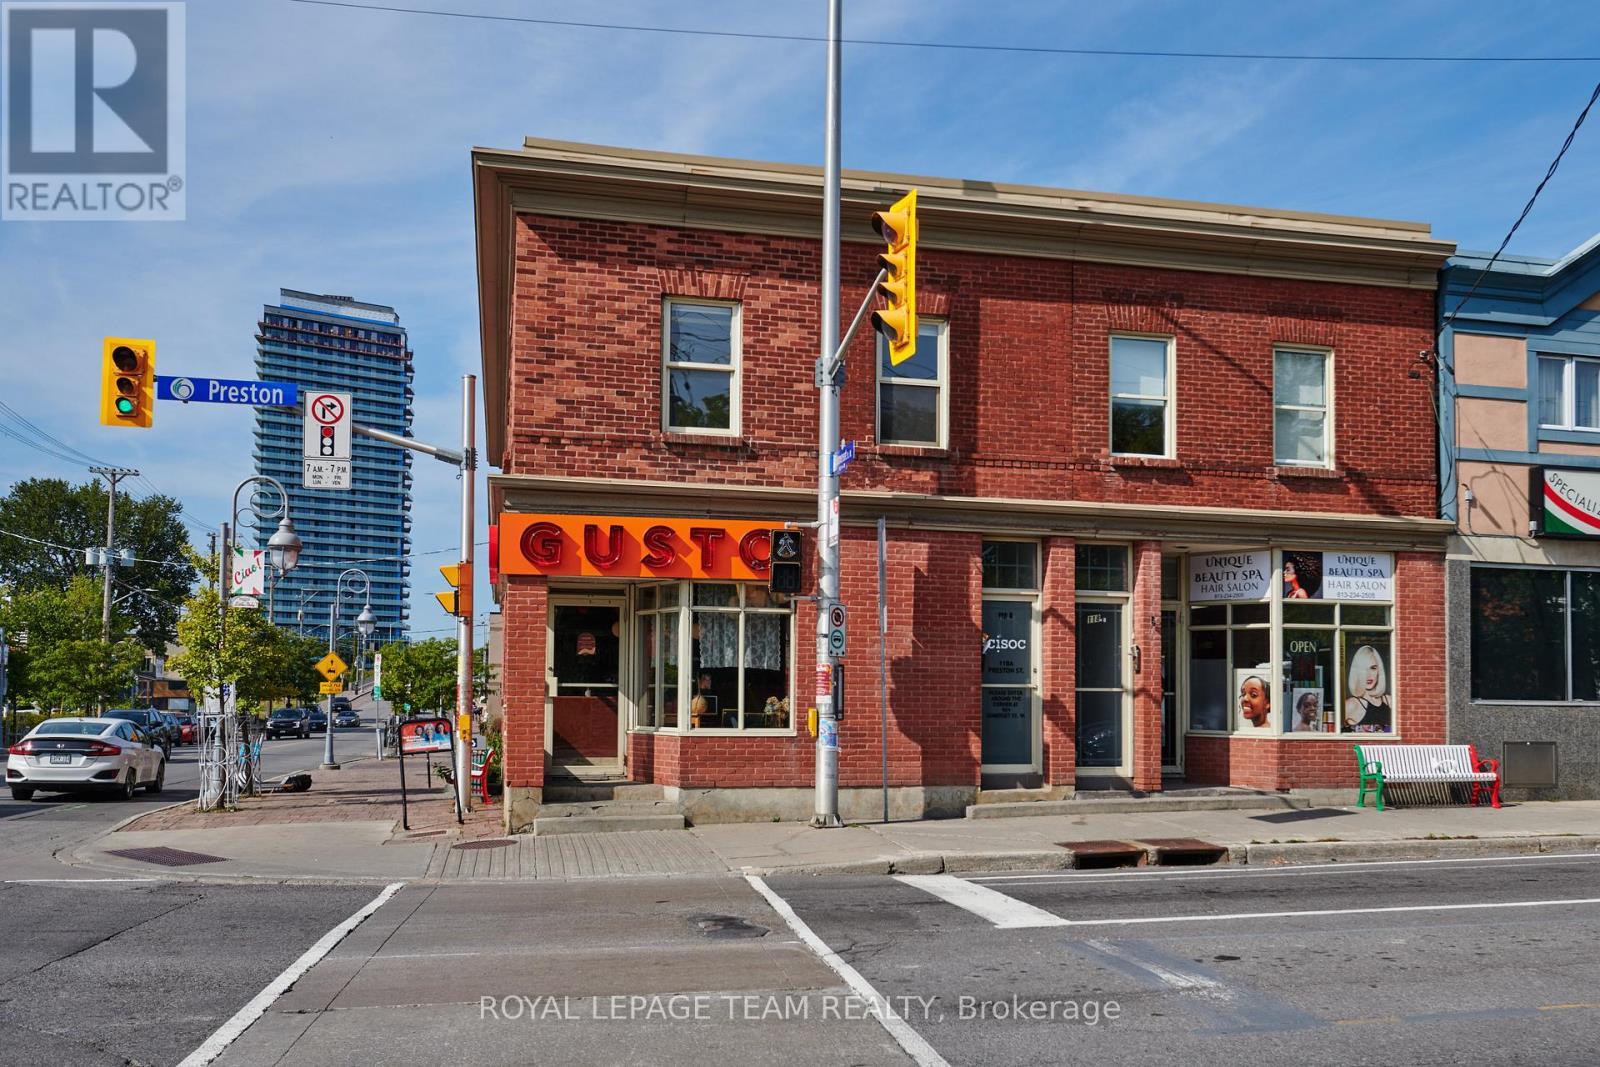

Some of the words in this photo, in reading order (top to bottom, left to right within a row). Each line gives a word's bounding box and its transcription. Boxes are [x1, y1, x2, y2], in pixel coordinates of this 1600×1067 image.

[208, 380, 283, 404] Preston
[306, 463, 311, 472] 7
[330, 464, 335, 472] 7
[1206, 554, 1253, 568] UNIQUE
[1337, 554, 1376, 567] UNIQUE
[234, 557, 262, 585] Ciao!
[1195, 571, 1238, 583] BEAUTY
[1241, 569, 1264, 581] SPA
[1328, 567, 1364, 577] BEAUTY
[1367, 568, 1385, 578] SPA
[1201, 583, 1224, 593] HAIR
[1227, 582, 1258, 592] SALON
[1327, 580, 1351, 589] HAIR
[1355, 581, 1387, 590] SALON
[1290, 640, 1317, 653] OPEN
